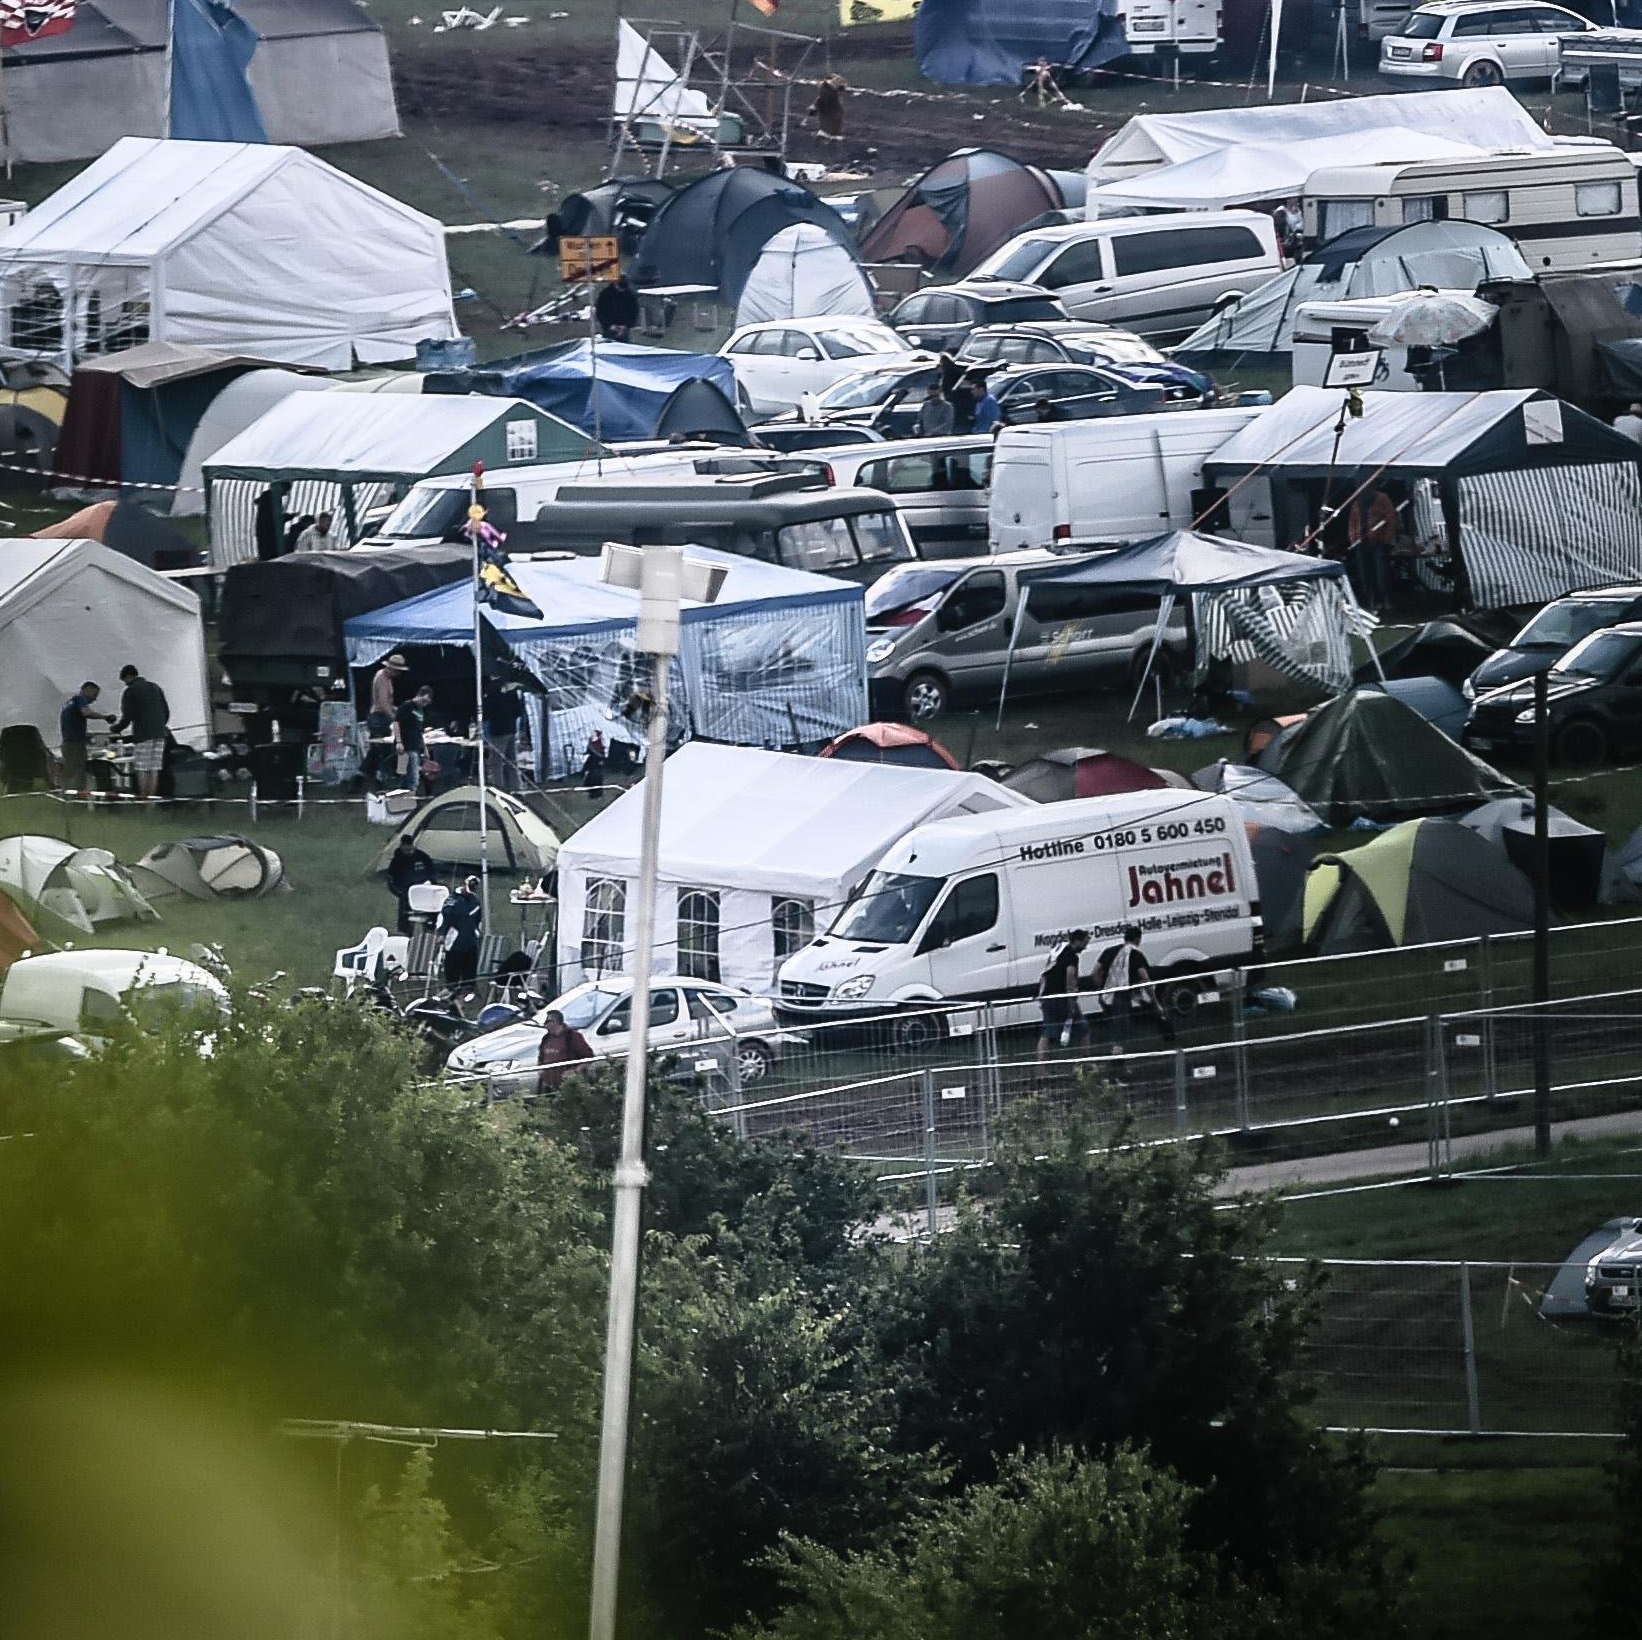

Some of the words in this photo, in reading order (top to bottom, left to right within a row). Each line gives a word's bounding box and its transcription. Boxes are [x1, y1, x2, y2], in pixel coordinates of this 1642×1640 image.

[1019, 840, 1085, 862] Hotline
[1093, 830, 1137, 851] 0180
[1140, 827, 1153, 844] 5
[1156, 822, 1189, 842] 600
[1194, 816, 1226, 835] 450
[1128, 852, 1236, 908] Jahnel
